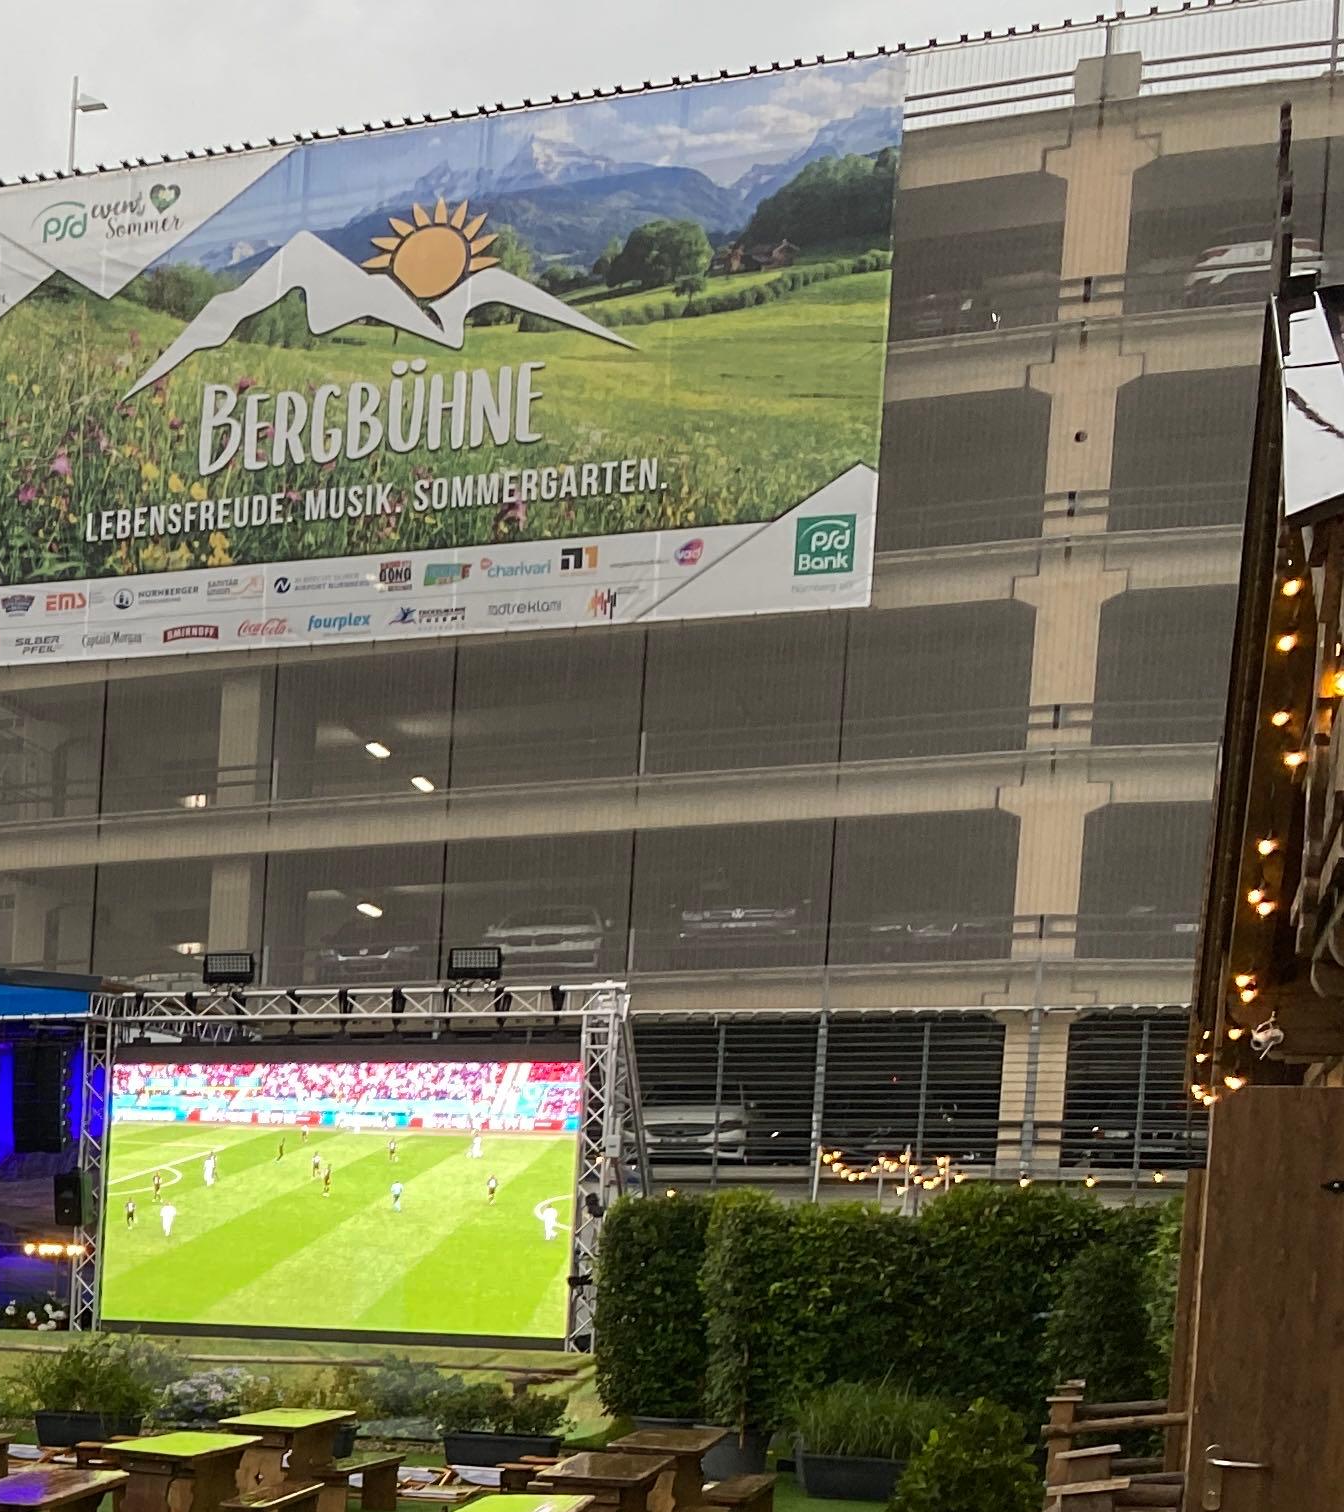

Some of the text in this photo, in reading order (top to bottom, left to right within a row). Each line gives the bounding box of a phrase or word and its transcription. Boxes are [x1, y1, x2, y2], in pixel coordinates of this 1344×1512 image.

[106, 214, 185, 240] Sommer
[199, 358, 546, 477] BERGBÜHNE
[85, 457, 669, 543] LEBENSFREUDE. MUSIK. SOMMERGARTEN.
[487, 559, 552, 578] charivari
[798, 551, 849, 572] Bank
[307, 612, 372, 633] fourplex
